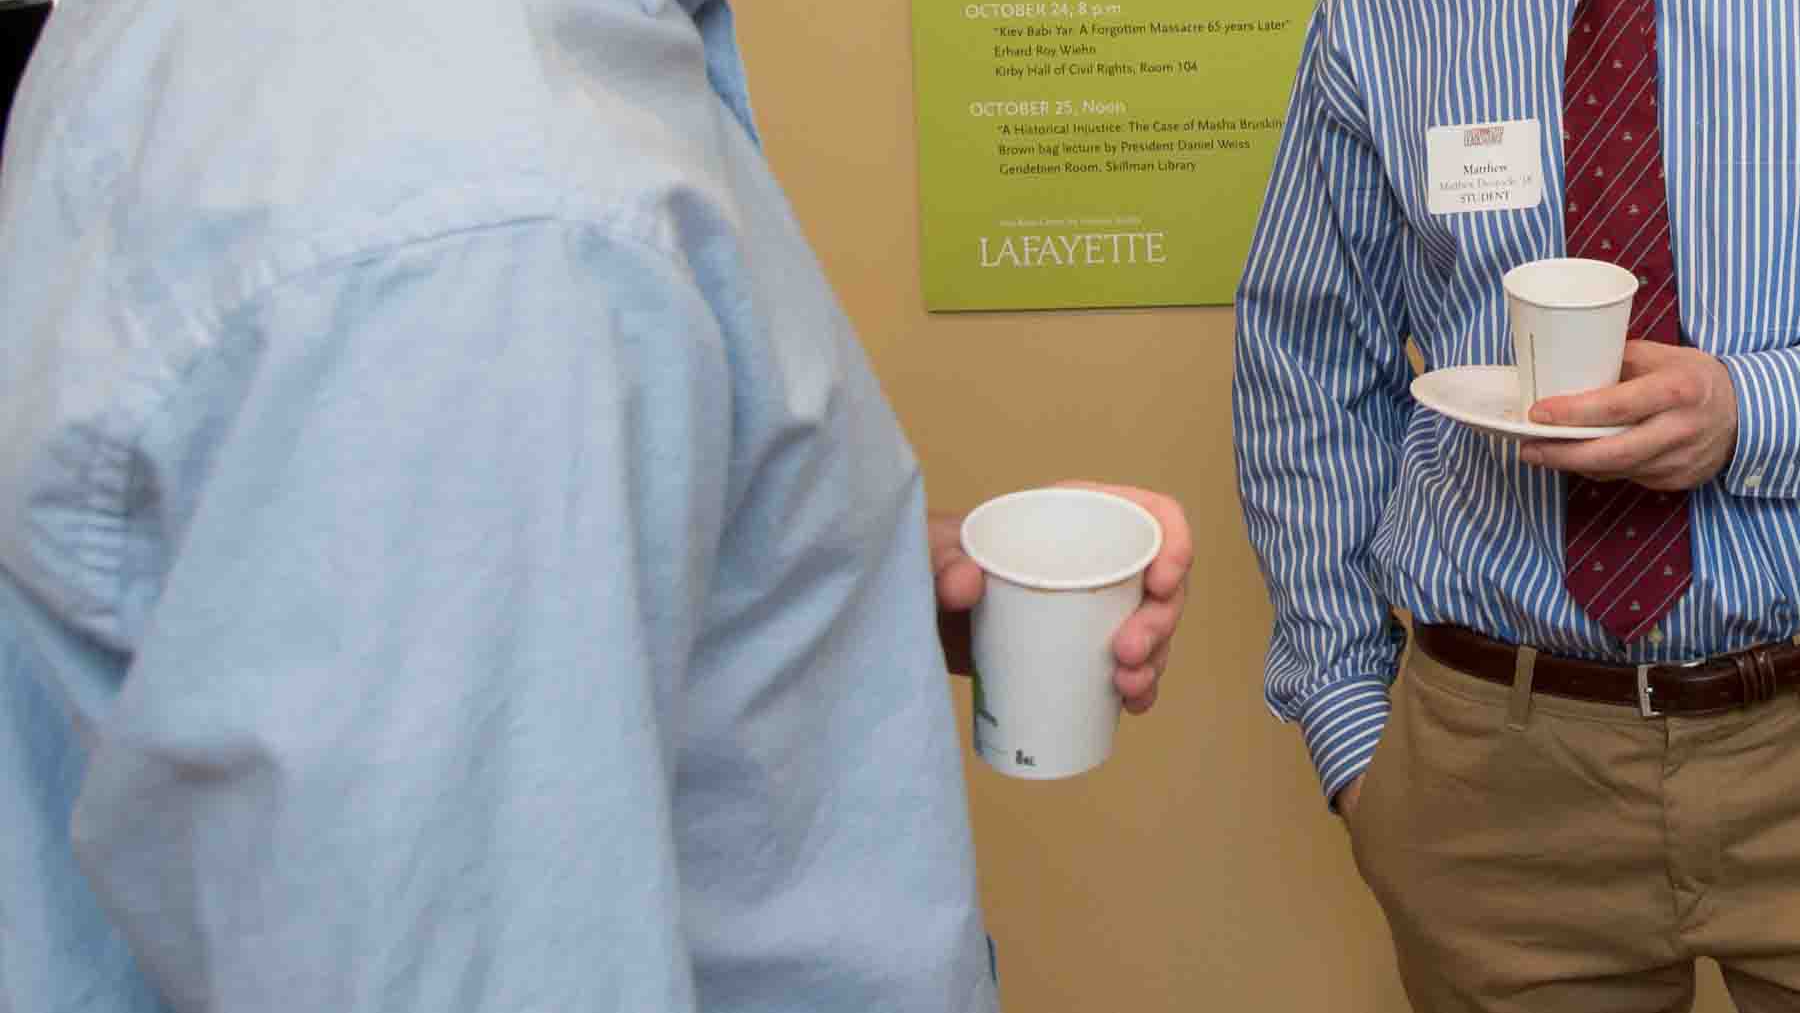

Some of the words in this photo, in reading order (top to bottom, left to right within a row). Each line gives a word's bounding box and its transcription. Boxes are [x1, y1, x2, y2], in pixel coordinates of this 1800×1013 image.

[965, 2, 1046, 19] OCTOBER
[1026, 26, 1052, 38] Babi
[1079, 24, 1088, 36] A
[1150, 22, 1203, 35] Massacre
[1207, 21, 1222, 33] 65
[1224, 22, 1254, 36] years
[994, 45, 1033, 58] Erhard
[1036, 45, 1057, 60] Roy
[1060, 44, 1097, 56] Wiehn
[995, 66, 1024, 80] Kirby
[1028, 64, 1051, 77] Hall
[1054, 64, 1067, 76] of
[1069, 63, 1094, 76] Civil
[1140, 62, 1174, 74] Room
[1177, 61, 1198, 73] 104
[970, 101, 1050, 118] OCTOBER
[1081, 100, 1126, 115] Noon
[1015, 123, 1069, 136] Historical
[1129, 120, 1150, 133] The
[1153, 120, 1180, 133] Case
[1183, 119, 1197, 132] of
[1199, 118, 1236, 131] Masha
[999, 144, 1035, 156] Brown
[1038, 144, 1059, 158] bag
[1062, 143, 1101, 156] lecture
[1104, 142, 1117, 157] by
[1121, 140, 1175, 154] President
[1177, 139, 1214, 151] Daniel
[1218, 138, 1251, 150] Weiss
[1106, 160, 1155, 173] Skillman
[1158, 160, 1197, 174] Library
[1457, 188, 1513, 204] STUDENT
[978, 231, 1169, 269] LAFAYETTE
